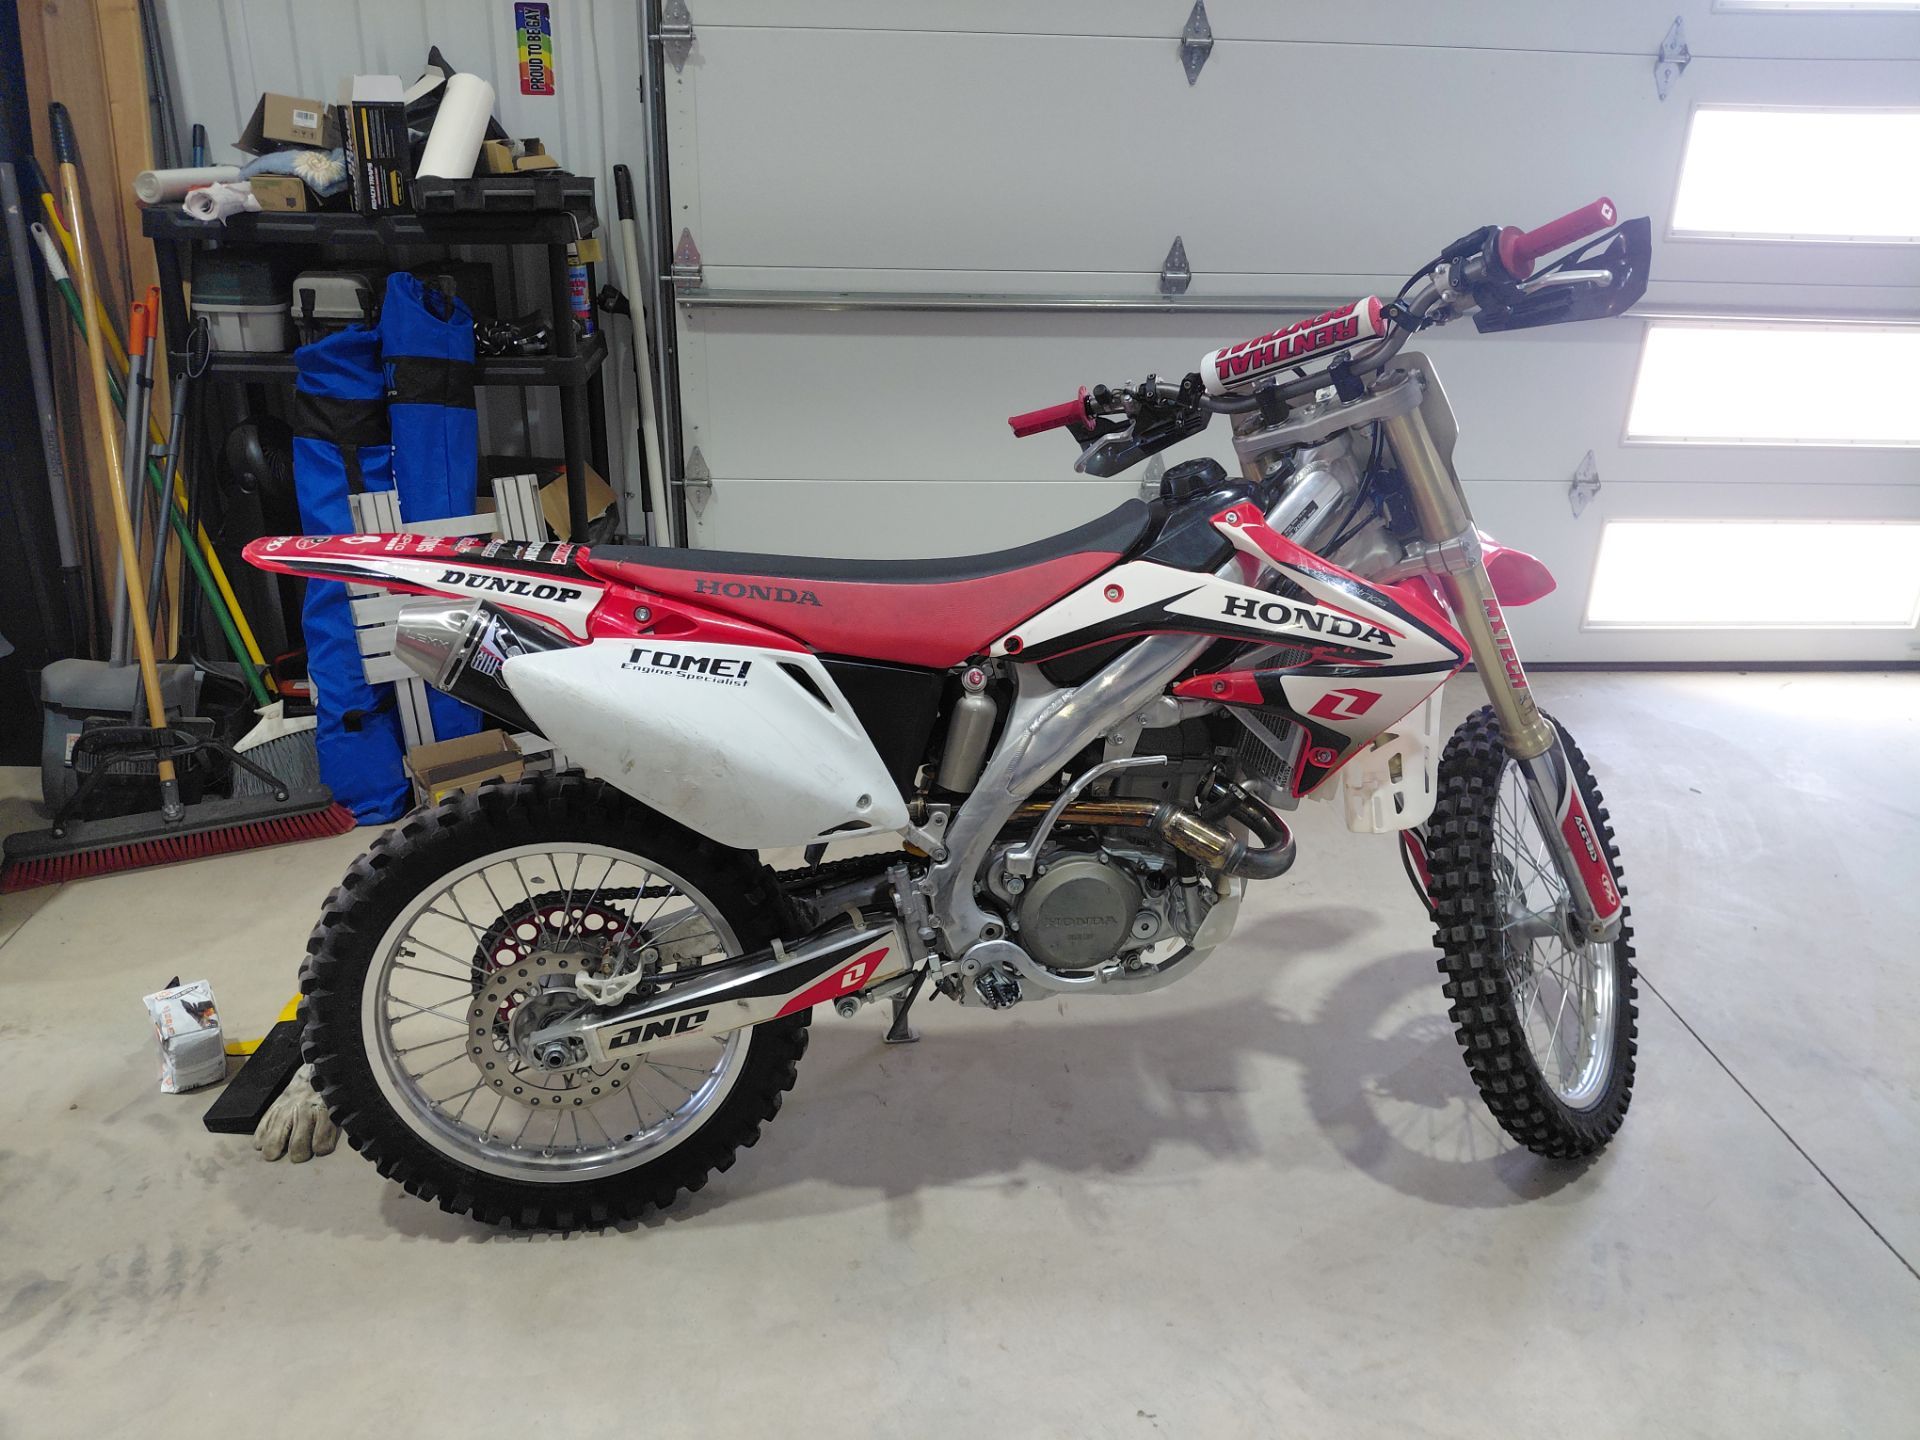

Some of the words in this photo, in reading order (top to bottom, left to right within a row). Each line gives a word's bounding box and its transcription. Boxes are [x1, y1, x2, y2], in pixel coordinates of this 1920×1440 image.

[524, 7, 540, 29] GAY
[526, 29, 541, 42] BE
[527, 44, 542, 56] TO
[529, 58, 545, 90] PROUD
[1215, 315, 1359, 379] RENTHAL
[438, 570, 582, 603] DUNLOP
[694, 579, 823, 606] HONDA
[1221, 595, 1396, 647] HONDA
[621, 662, 673, 678] Engine
[676, 670, 749, 687] Specialist
[629, 648, 752, 679] TOMEI
[1044, 916, 1118, 928] HONDA
